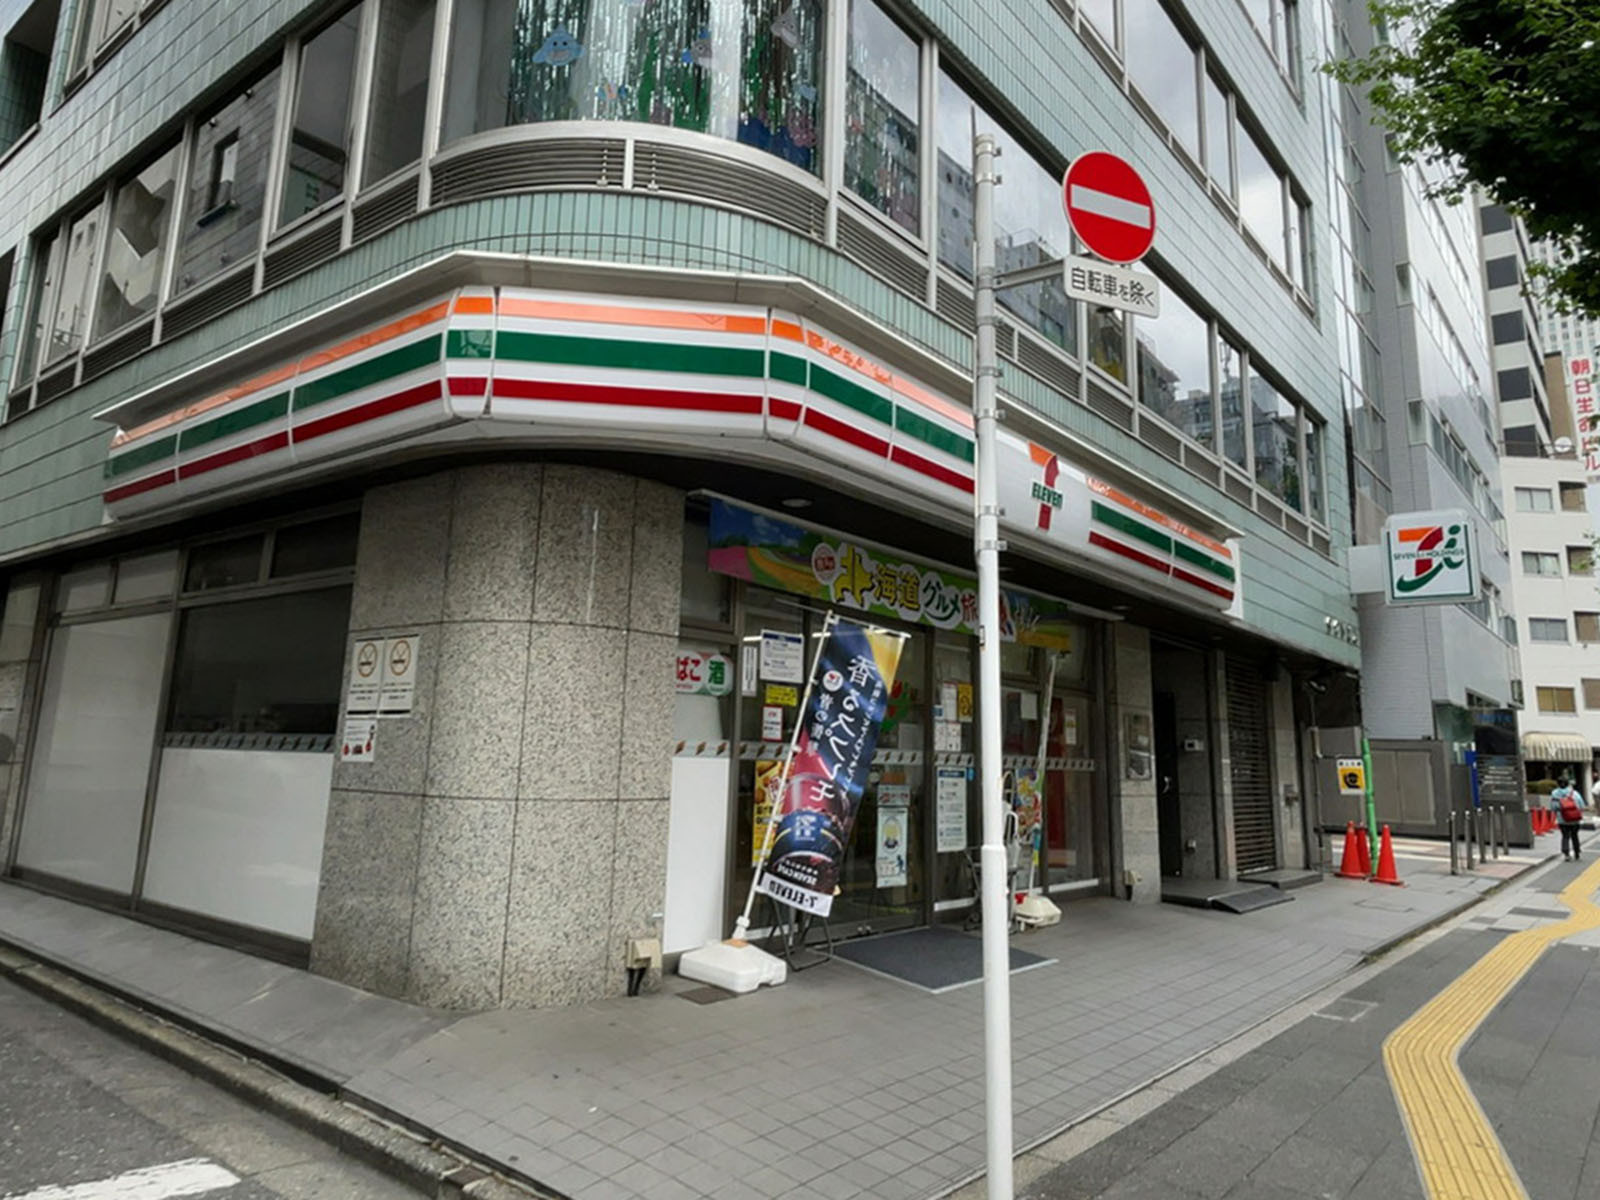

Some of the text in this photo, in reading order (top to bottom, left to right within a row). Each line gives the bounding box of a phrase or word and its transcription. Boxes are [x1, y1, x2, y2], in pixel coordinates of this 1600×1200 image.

[1071, 266, 1155, 308] 自転車を除く
[708, 660, 726, 686] 酒
